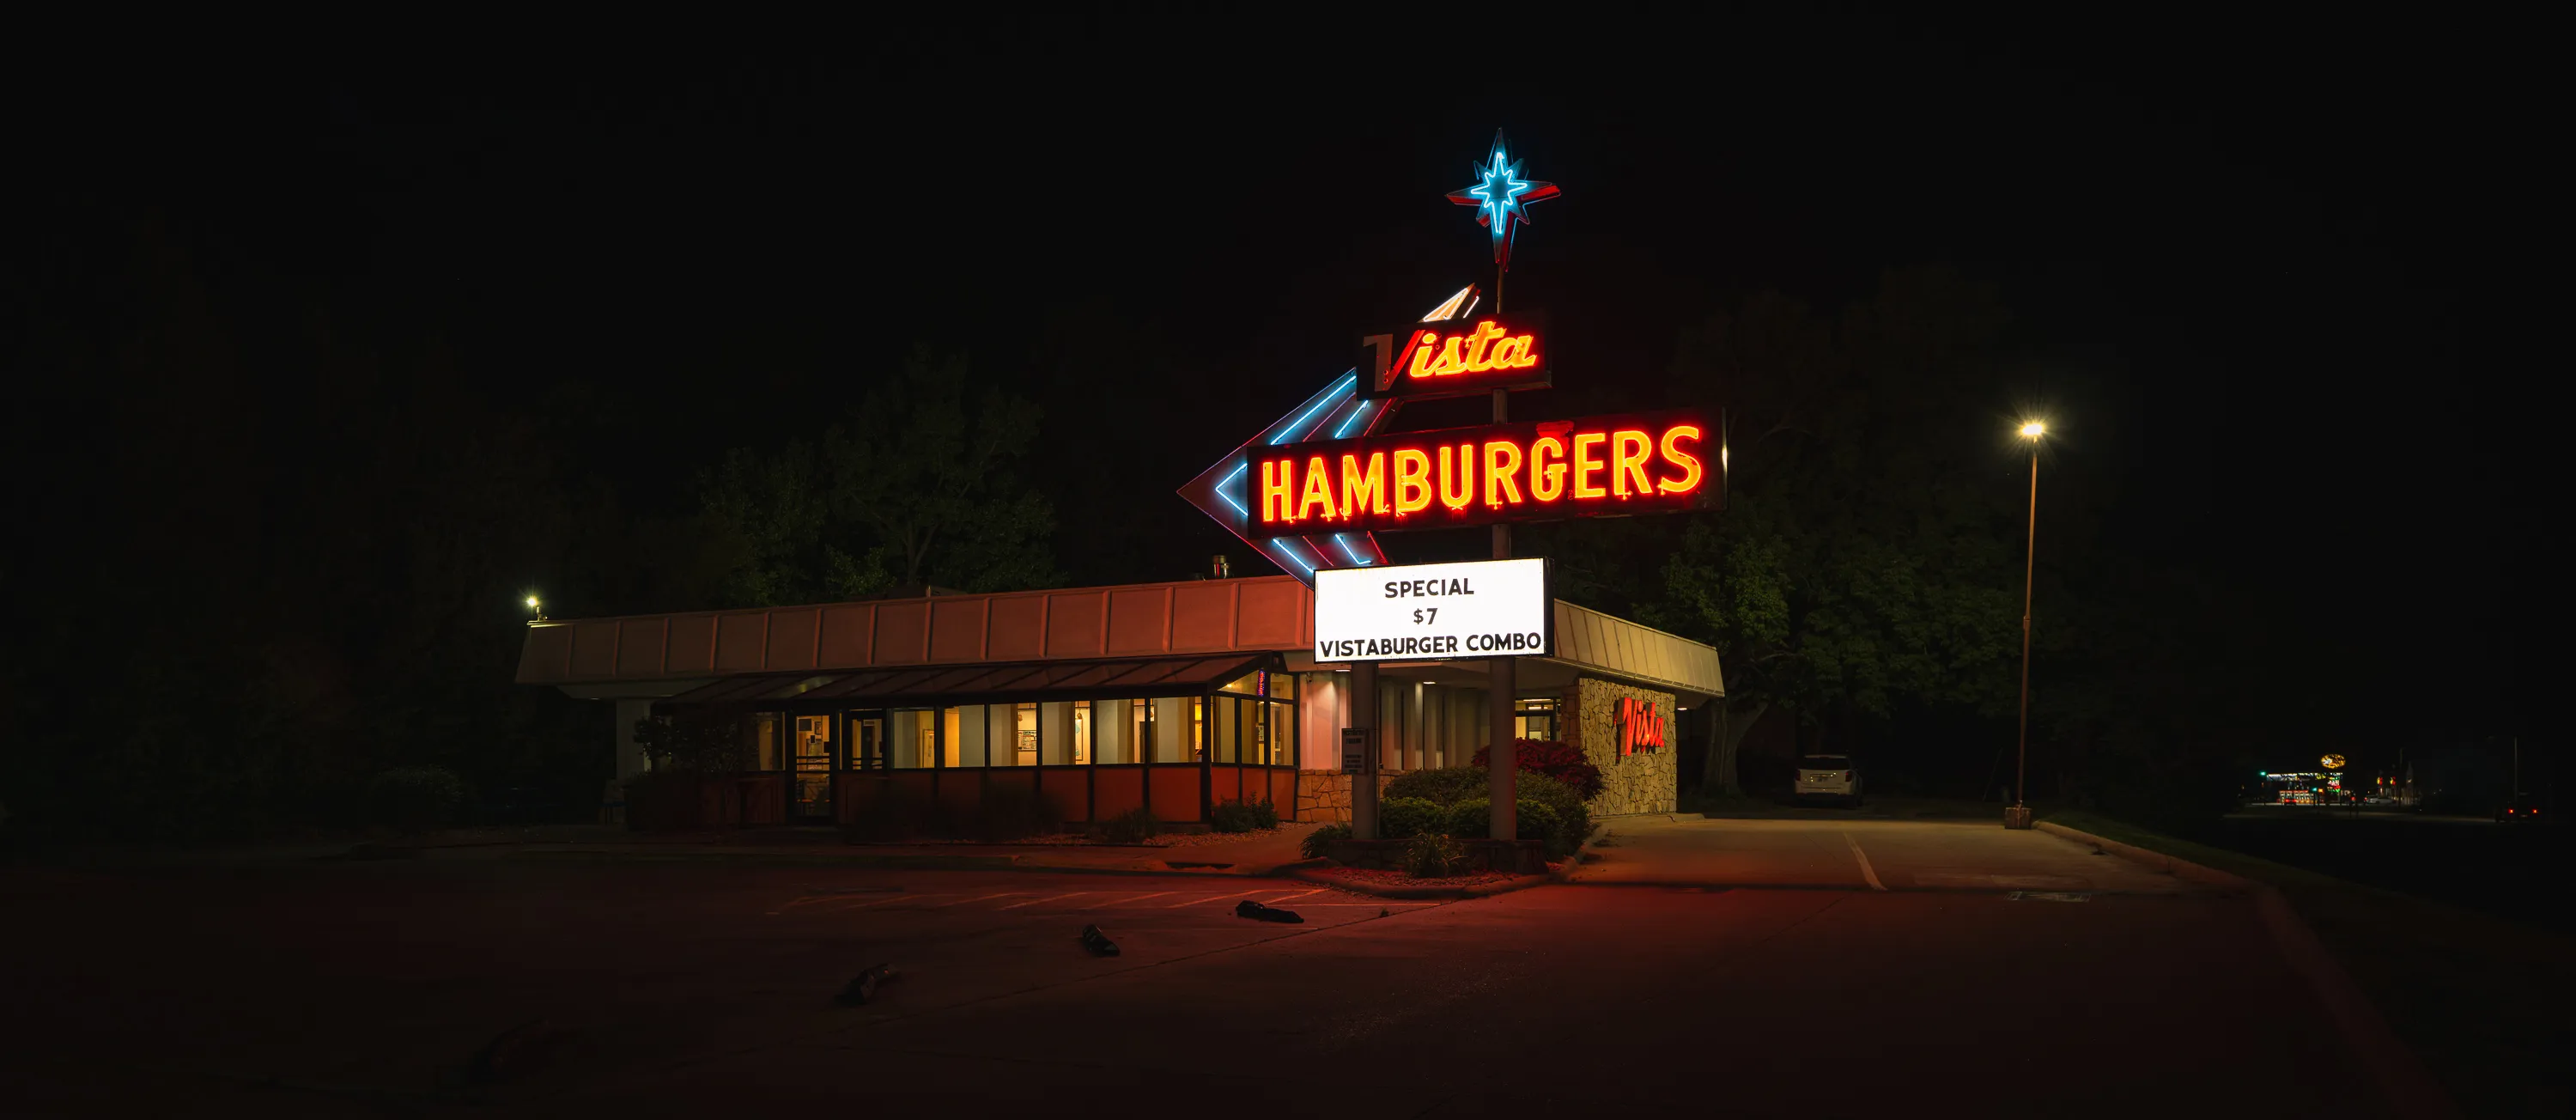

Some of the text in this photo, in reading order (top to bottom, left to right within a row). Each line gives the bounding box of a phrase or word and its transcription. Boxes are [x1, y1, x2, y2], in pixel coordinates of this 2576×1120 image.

[1363, 320, 1537, 392] Vista
[1262, 426, 1702, 522] HAMBURGERS
[1384, 578, 1474, 599] SPECIAL
[1413, 608, 1438, 624] $7
[1320, 632, 1541, 657] VISTABURGER COMBO
[1620, 697, 1665, 756] Vista
